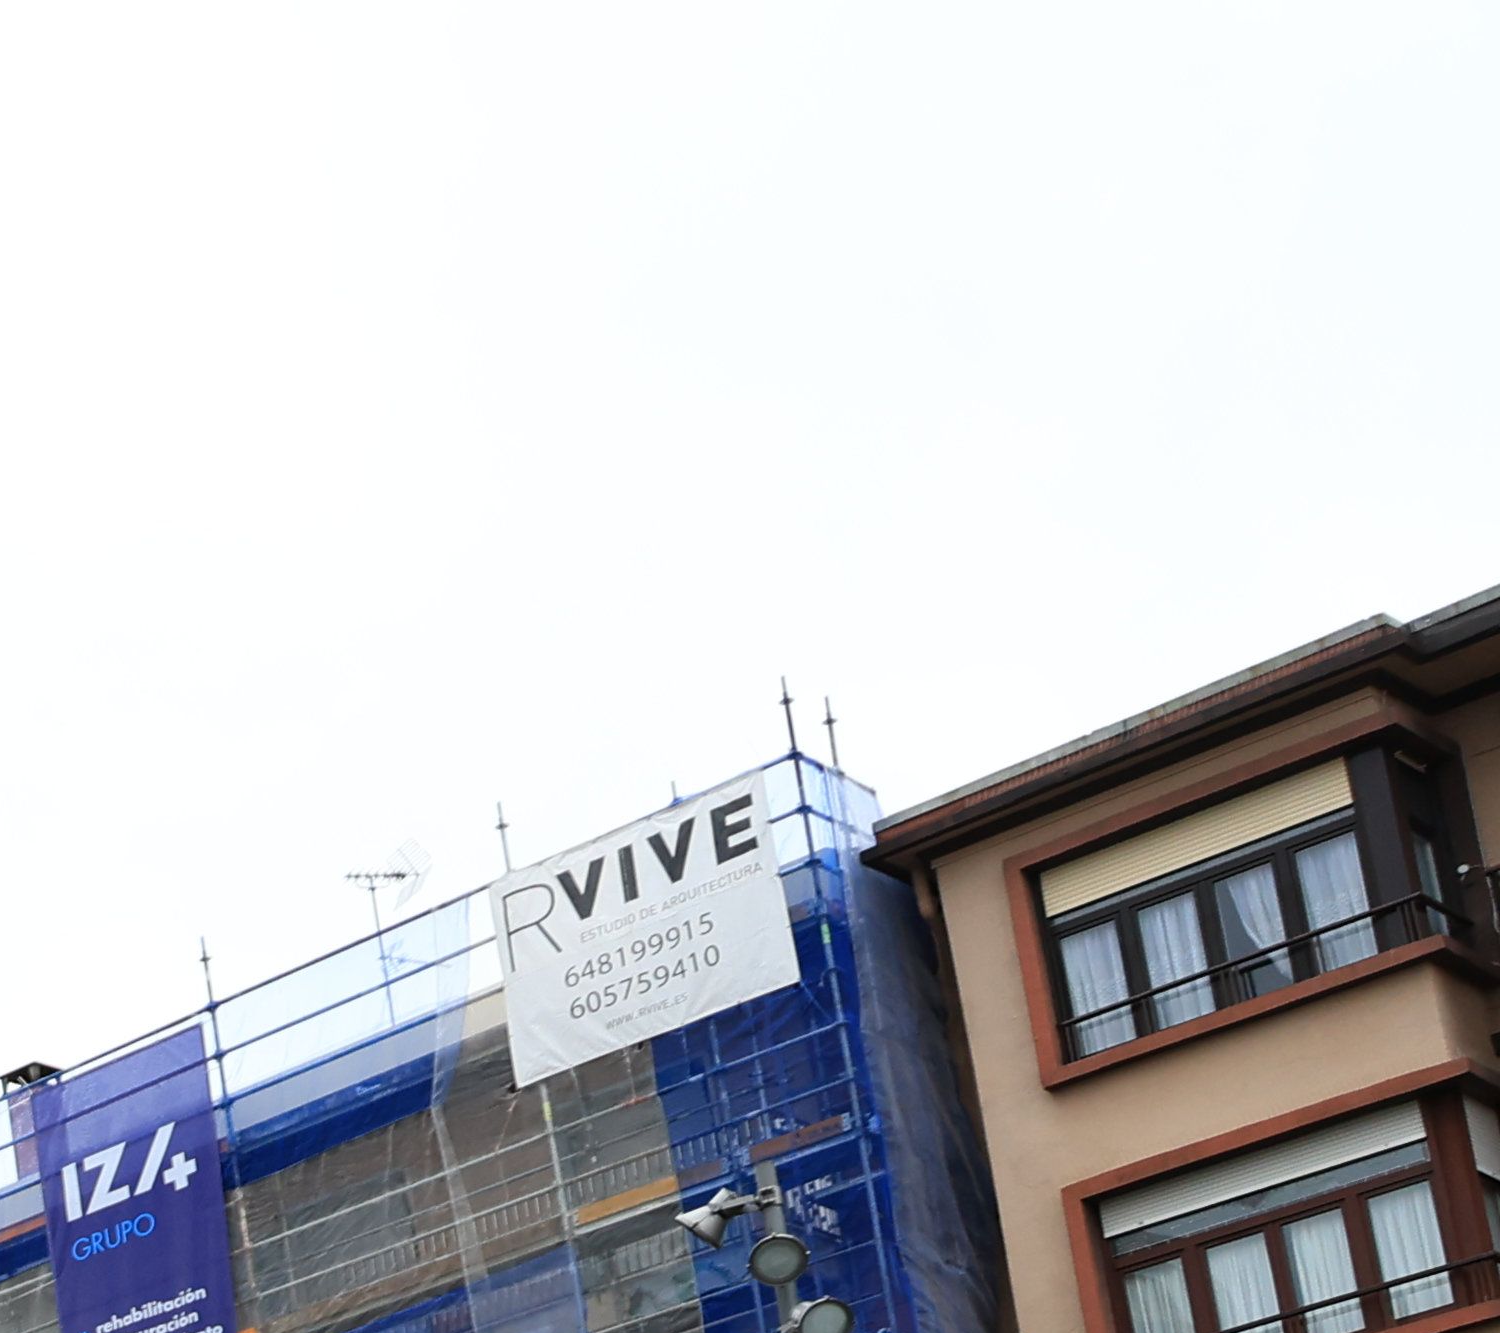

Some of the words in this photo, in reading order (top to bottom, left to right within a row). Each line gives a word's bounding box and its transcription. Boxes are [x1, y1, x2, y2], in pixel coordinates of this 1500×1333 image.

[502, 793, 759, 972] RVIVE
[580, 915, 637, 943] ESTUDIO
[639, 903, 659, 920] DE
[661, 861, 763, 912] ARQUITECTURA
[564, 911, 715, 988] 648199915
[570, 944, 720, 1019] 605759410
[72, 1212, 156, 1261] GRUPO
